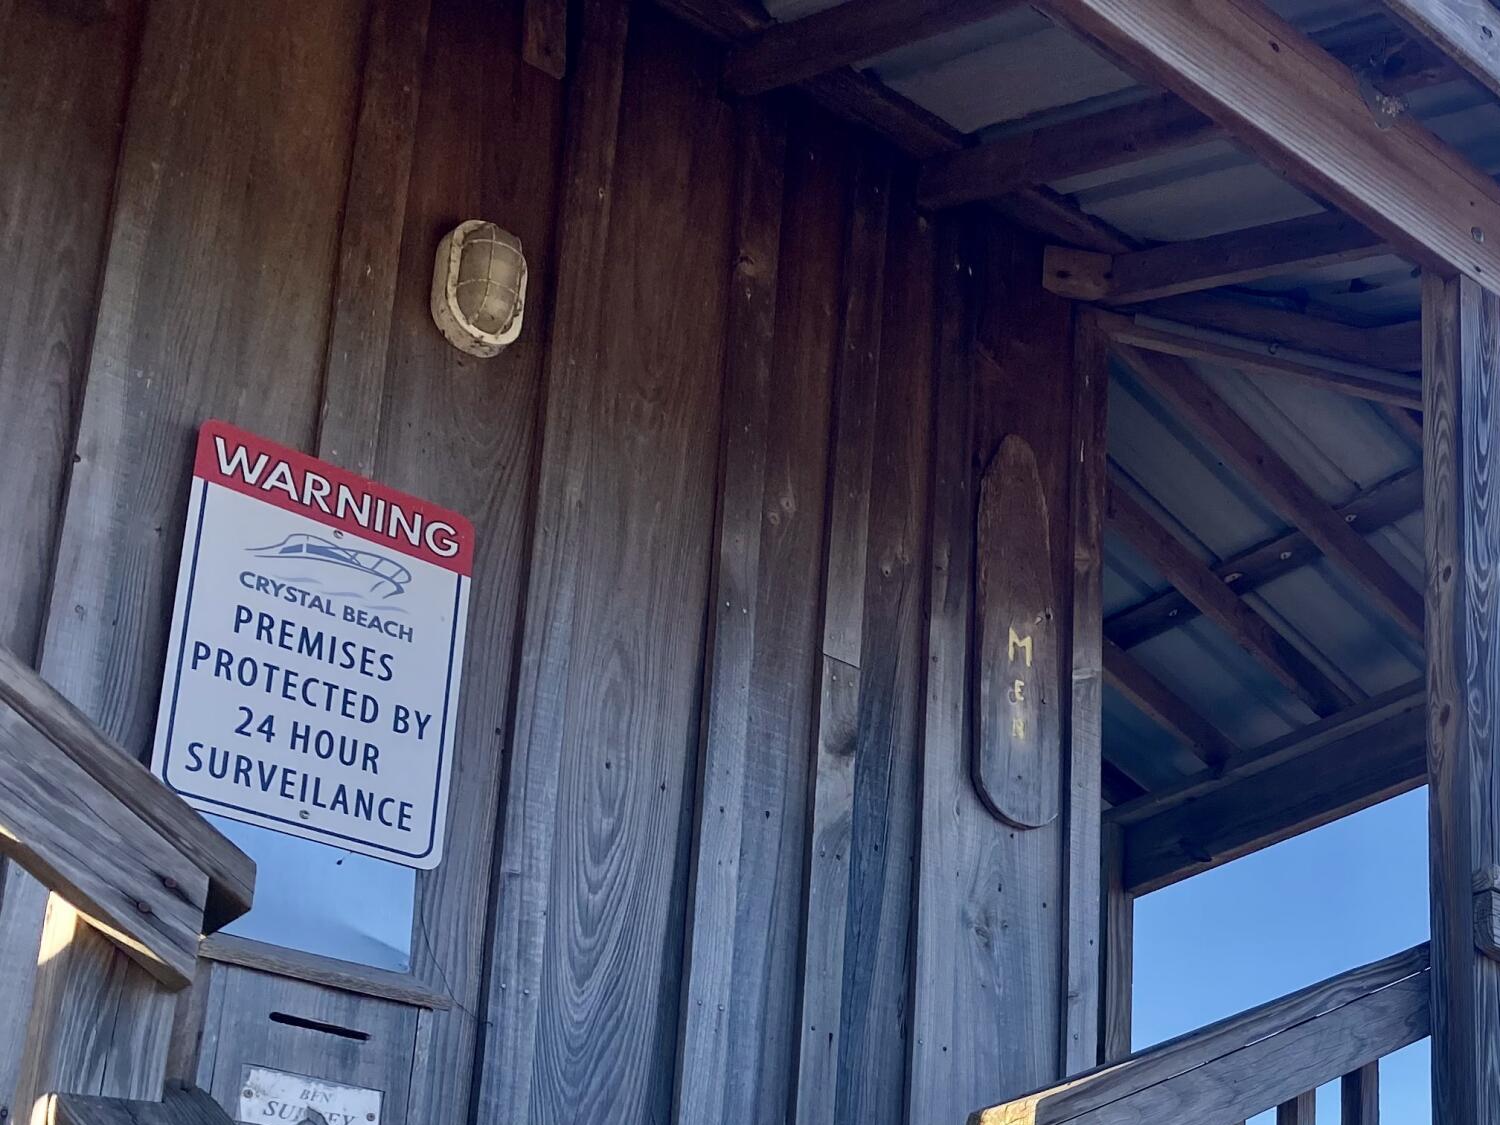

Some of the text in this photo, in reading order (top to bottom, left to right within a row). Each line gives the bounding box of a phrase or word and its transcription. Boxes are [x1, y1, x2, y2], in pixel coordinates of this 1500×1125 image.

[214, 436, 461, 558] WARNING
[233, 605, 394, 682] PREMISES
[238, 570, 414, 643] CRYSTAL BEACH
[191, 641, 433, 741] PROTECTED BY
[234, 705, 380, 775] 24 HOUR
[184, 741, 414, 833] SURVEILANCE
